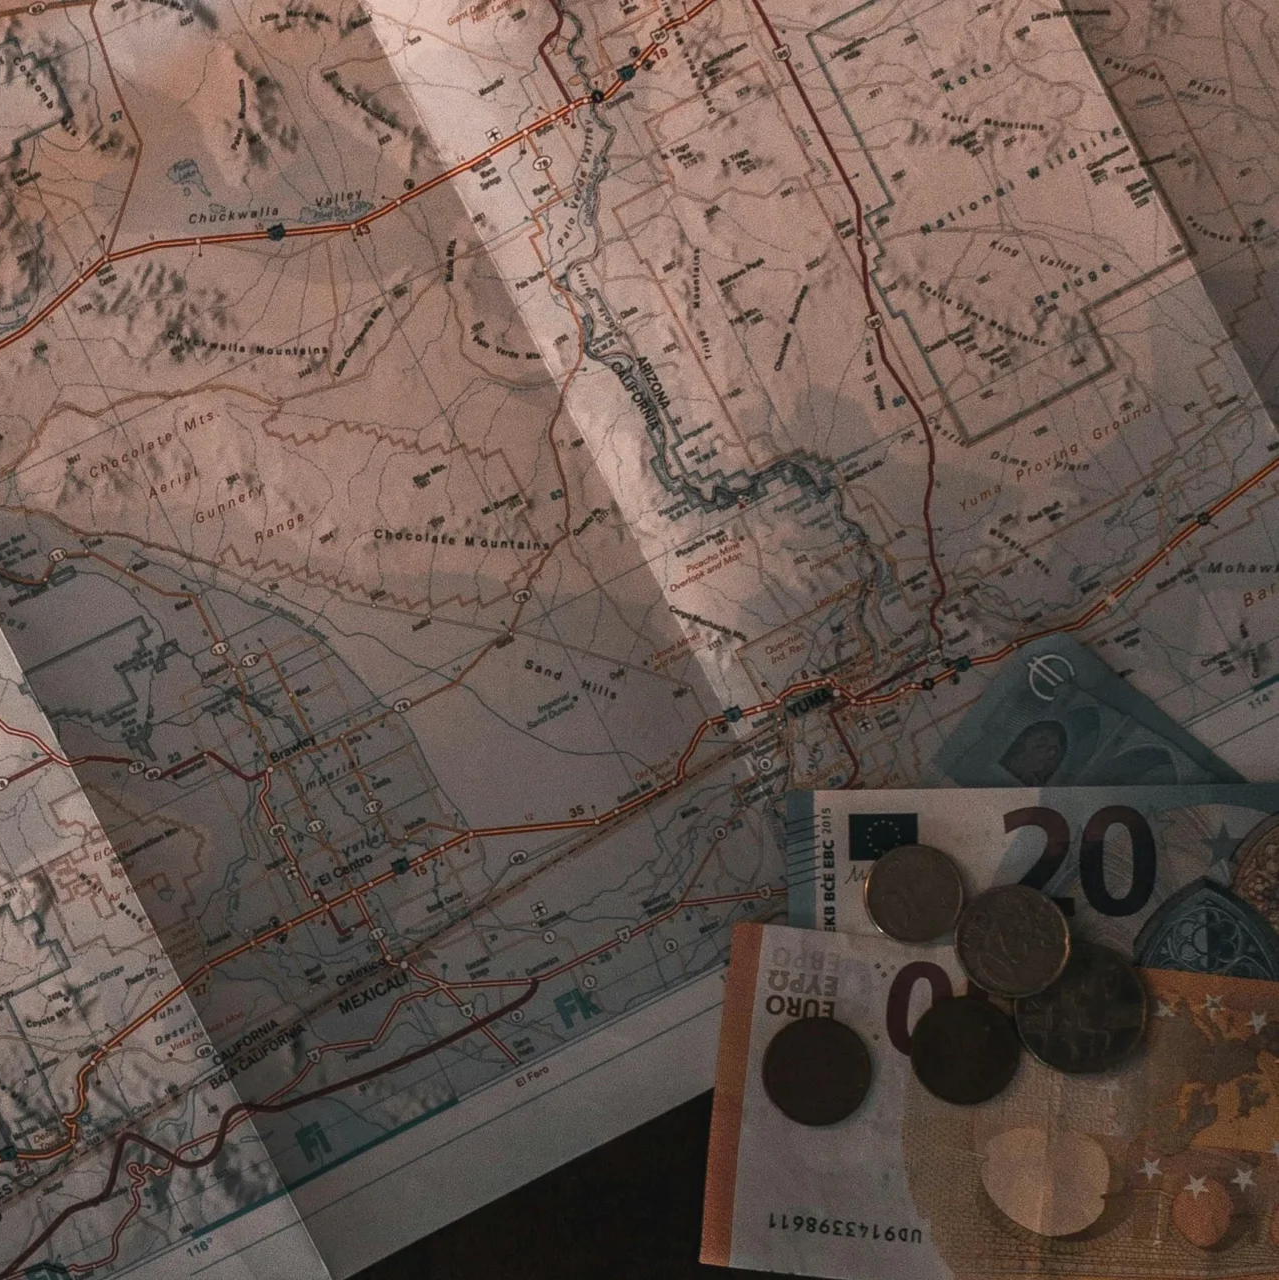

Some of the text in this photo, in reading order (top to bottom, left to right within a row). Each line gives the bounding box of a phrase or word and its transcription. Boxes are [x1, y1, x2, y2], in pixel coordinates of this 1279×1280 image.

[652, 48, 669, 61] 19
[14, 57, 55, 110] Coxcomb
[942, 62, 993, 93] Kofa
[1104, 57, 1227, 97] Palomas Plain
[1026, 125, 1123, 181] Wildlife
[188, 188, 363, 226] Chuckwalla Valley
[921, 181, 1015, 235] National
[557, 217, 576, 248] Palo
[989, 239, 1082, 274] King Valley
[1034, 263, 1112, 306] Refuge
[610, 360, 663, 433] CALIFORNIA
[635, 355, 673, 411] ARIZONA
[88, 409, 221, 479] Chocolate Mts.
[1015, 401, 1153, 482] Proving Ground
[147, 466, 201, 500] Aerial
[958, 484, 1004, 513] Yuma
[195, 482, 267, 525] Gunnery
[253, 511, 307, 545] Range
[523, 659, 619, 701] Sand Hills
[787, 688, 833, 718] YUMA
[270, 735, 317, 764] Brawley
[821, 807, 832, 835] 2015
[320, 855, 373, 886] El Centro
[822, 839, 835, 869] EBC
[1002, 804, 1158, 919] 20
[151, 1003, 182, 1023] Yuha
[553, 986, 602, 1030] Fk
[765, 994, 835, 1021] EURO
[154, 1020, 198, 1046] Desert
[212, 1019, 279, 1066] CALIFORNIA
[238, 1024, 307, 1072] CALIFORNIA
[767, 1211, 923, 1246] UD9143398611
